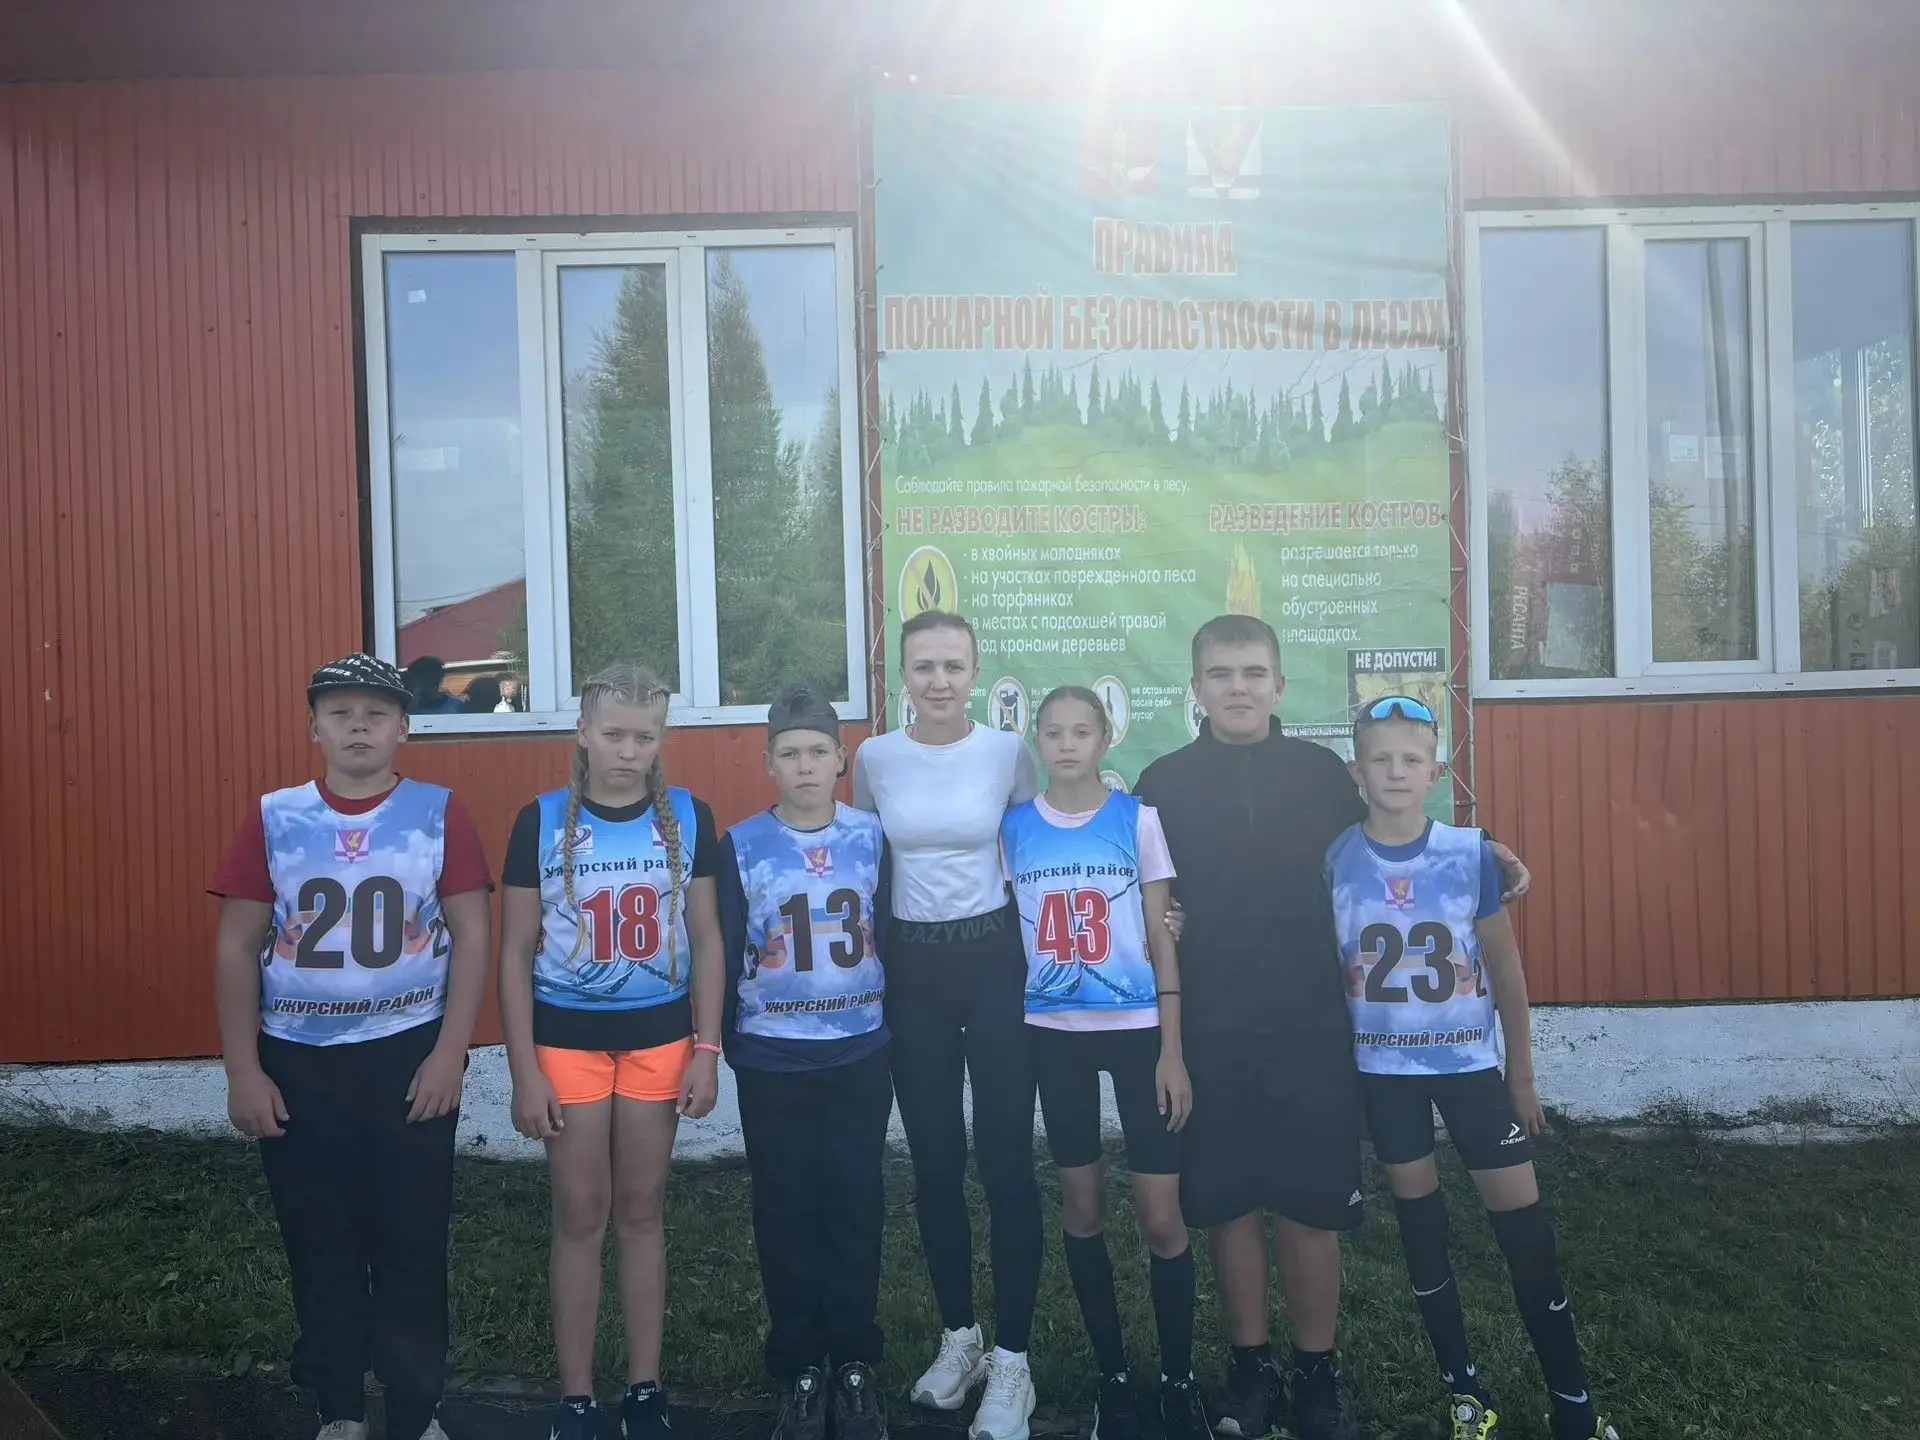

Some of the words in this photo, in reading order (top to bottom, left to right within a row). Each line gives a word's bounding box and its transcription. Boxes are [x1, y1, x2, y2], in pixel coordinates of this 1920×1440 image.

[1093, 218, 1236, 275] ПРАВИЛА
[883, 283, 1054, 351] ПОЖАРНОЙ
[1061, 295, 1315, 351] БЕЗОПАСТНОСТИ
[1321, 298, 1343, 351] В
[896, 475, 963, 494] Соблюдайте
[967, 478, 1013, 498] правила
[1016, 476, 1071, 498] пожарной
[1075, 474, 1150, 492] безопасности
[1153, 479, 1160, 490] в
[897, 506, 923, 534] НЕ
[929, 505, 1050, 537] РАЗВОДИТЕ
[1054, 504, 1147, 533] КОСТРЫ:
[1209, 502, 1342, 535] РАЗВЕДЕНИЕ
[1347, 499, 1442, 529] КОСТРОВ
[971, 548, 978, 561] в
[981, 544, 1037, 561] хвойных
[1041, 547, 1121, 564] молодняках
[1281, 545, 1370, 565] разрешается
[1374, 543, 1419, 561] только
[971, 570, 988, 584] на
[992, 569, 1051, 592] участках
[1054, 568, 1160, 590] поврежденного
[1164, 568, 1196, 583] леса
[1281, 575, 1298, 588] на
[1302, 571, 1382, 589] специально
[971, 593, 988, 608] на
[992, 587, 1074, 614] торфяниках
[1282, 594, 1378, 620] обустроенных
[972, 616, 980, 630] в
[983, 616, 1028, 630] местах
[1031, 616, 1039, 629] с
[1042, 611, 1116, 633] подсохшей
[1120, 609, 1167, 636] травой
[1001, 638, 1058, 659] кронами
[1062, 637, 1126, 659] деревьев
[1282, 627, 1361, 645] площадках.
[1355, 653, 1371, 668] НЕ
[1374, 651, 1438, 671] ДОПУСТИ!
[1086, 862, 1135, 878] район
[296, 875, 405, 969] 20
[579, 883, 662, 963] 18
[778, 888, 865, 973] 13
[1036, 887, 1111, 965] 43
[1359, 921, 1457, 1004] 23
[273, 997, 371, 1017] УЖУРСКИЙ
[375, 986, 435, 1013] РАЙОН
[764, 997, 848, 1013] УЖУРСКИЙ
[1433, 1027, 1484, 1047] РАЙОН
